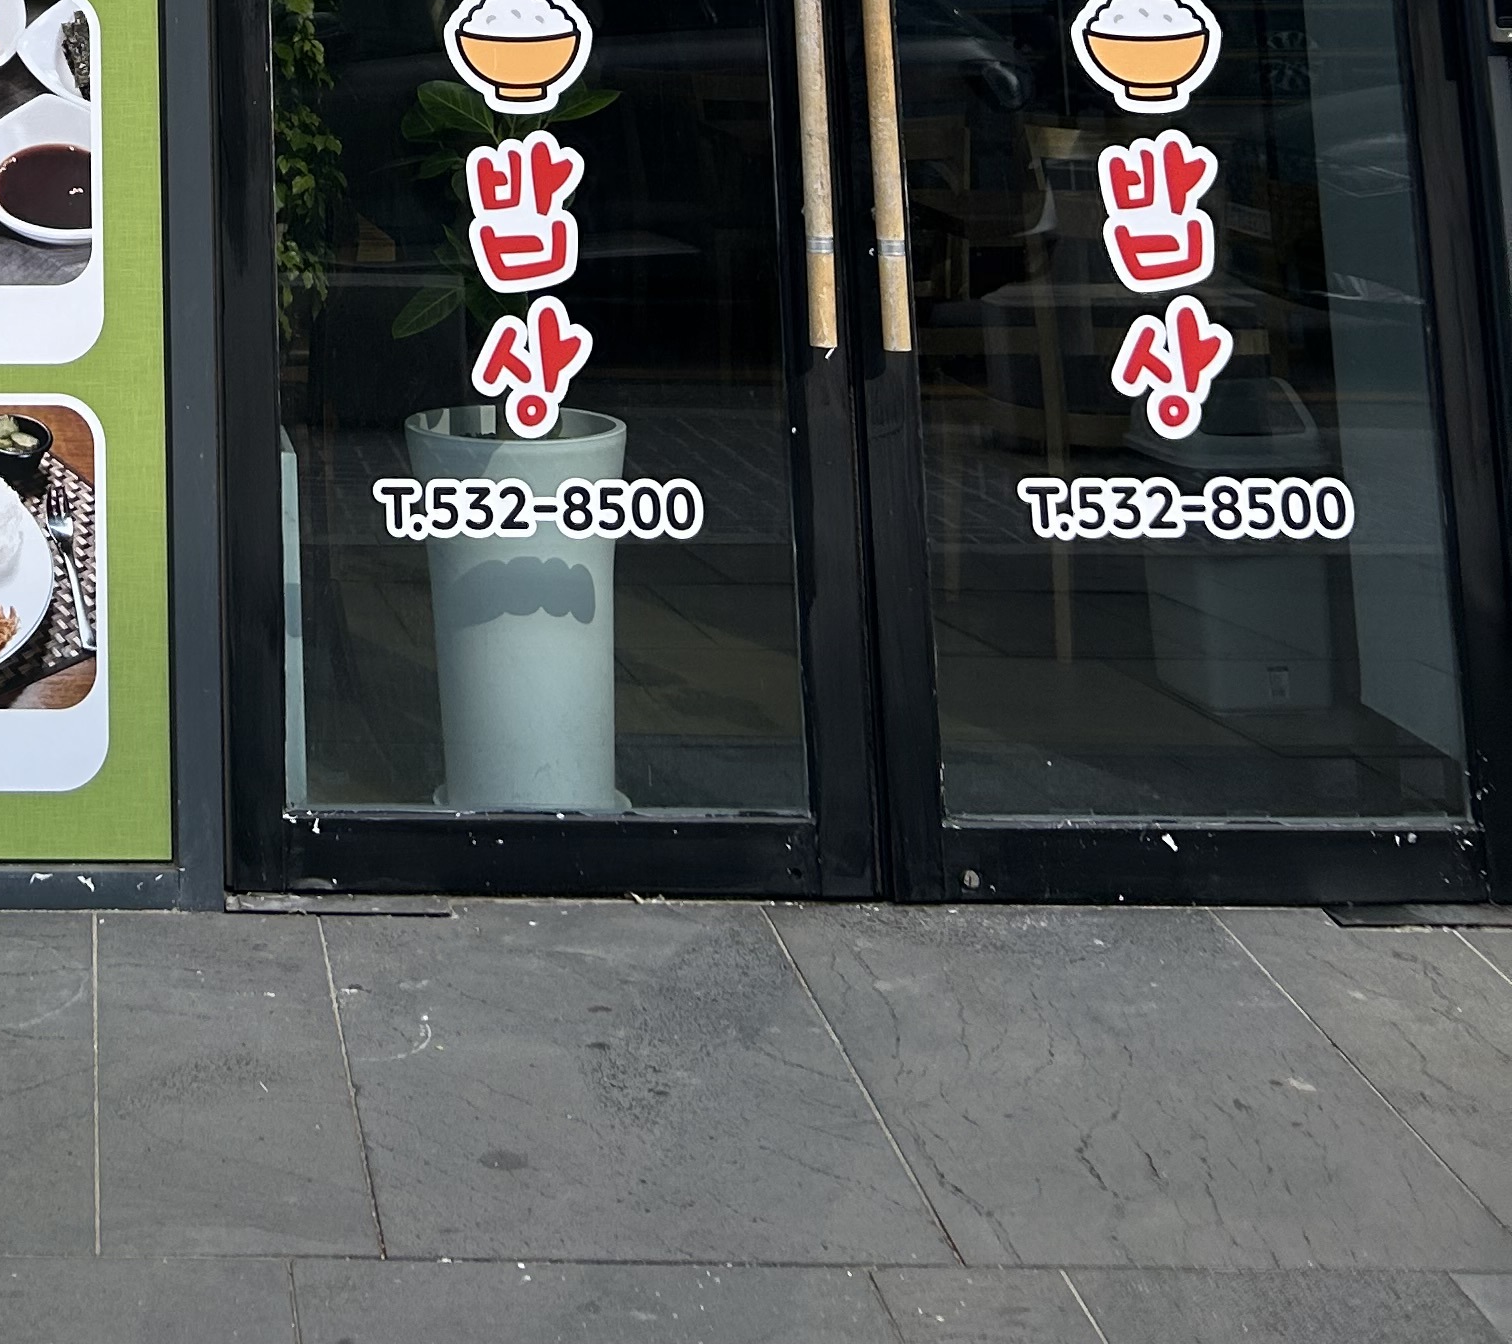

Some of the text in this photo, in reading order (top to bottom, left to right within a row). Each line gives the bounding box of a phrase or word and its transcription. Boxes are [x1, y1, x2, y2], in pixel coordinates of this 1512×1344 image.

[474, 130, 592, 435] 밥상
[1109, 130, 1232, 434] 밥상
[380, 482, 697, 537] T.532-8500
[1026, 482, 1349, 536] T.532-8500
